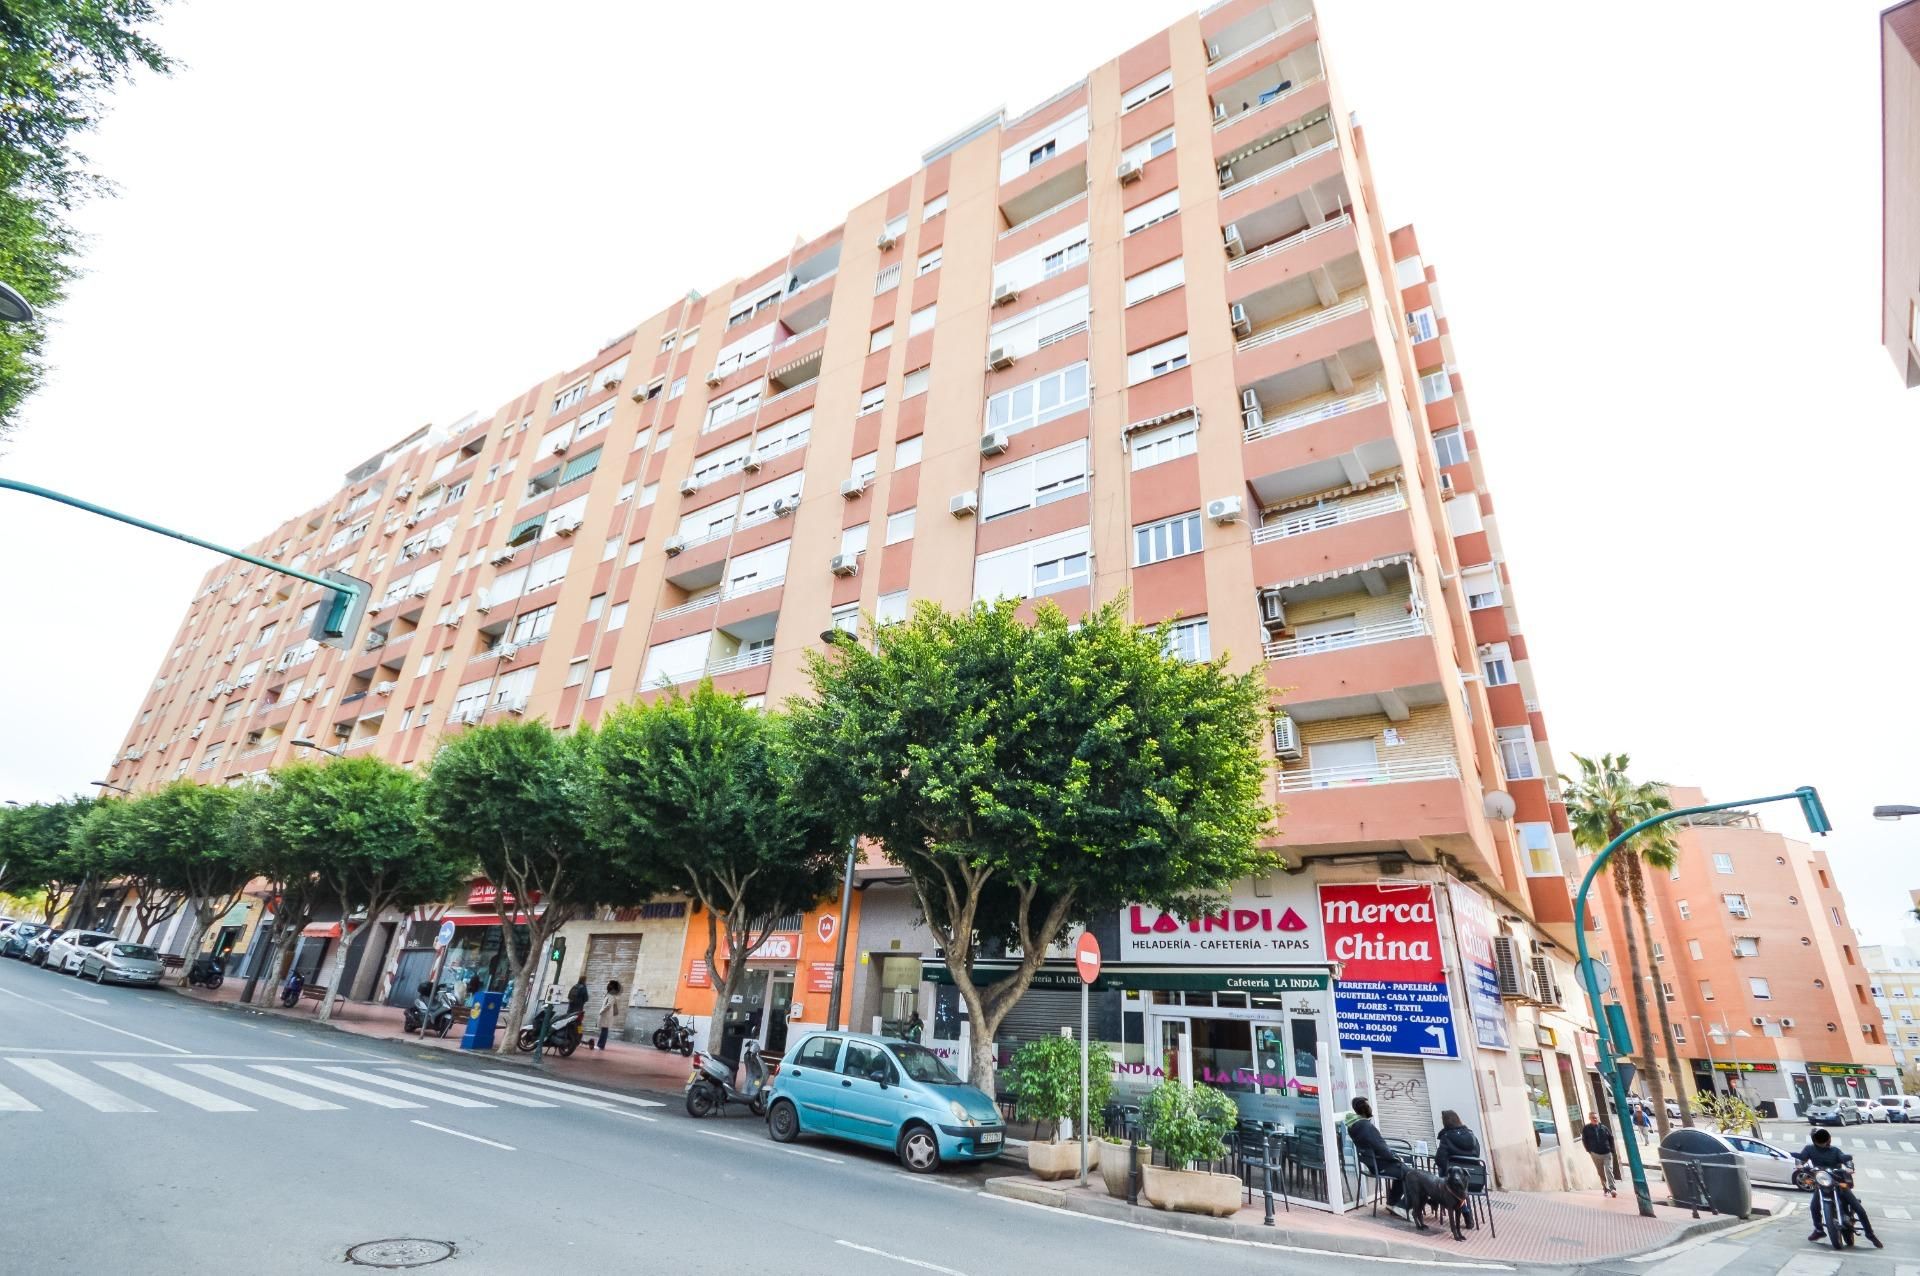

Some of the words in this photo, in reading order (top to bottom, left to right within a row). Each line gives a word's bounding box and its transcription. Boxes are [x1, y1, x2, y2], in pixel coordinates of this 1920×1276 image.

[1324, 900, 1433, 923] Merca
[1130, 905, 1179, 934] LA
[1188, 906, 1308, 933] INDIA
[1132, 938, 1191, 949] HELADERÍA
[1200, 938, 1261, 950] CAFETERÍA
[1271, 939, 1310, 950] TAPAS
[1335, 932, 1432, 961] China
[1056, 976, 1067, 984] LA
[1068, 976, 1082, 984] IND
[1227, 978, 1269, 987] Cafetería
[1274, 979, 1288, 988] LA
[1290, 979, 1319, 988] INDIA
[1338, 981, 1386, 990] FERRETERÍA
[1393, 983, 1438, 992] PAPELERÍA
[1386, 993, 1408, 1001] CASA
[1417, 993, 1449, 1003] JARDÍN
[1357, 1003, 1387, 1011] FLORES
[1394, 1005, 1423, 1013] TEXTIL
[1337, 1012, 1403, 1022] COMPLEMENTOS
[1410, 1016, 1449, 1024] CALZADO
[1338, 1023, 1359, 1031] ROPA
[1366, 1024, 1398, 1032] BOLSOS
[1339, 1032, 1392, 1042] DECORACIÓN
[1203, 1066, 1231, 1084] LA
[1236, 1068, 1301, 1089] INDIA
